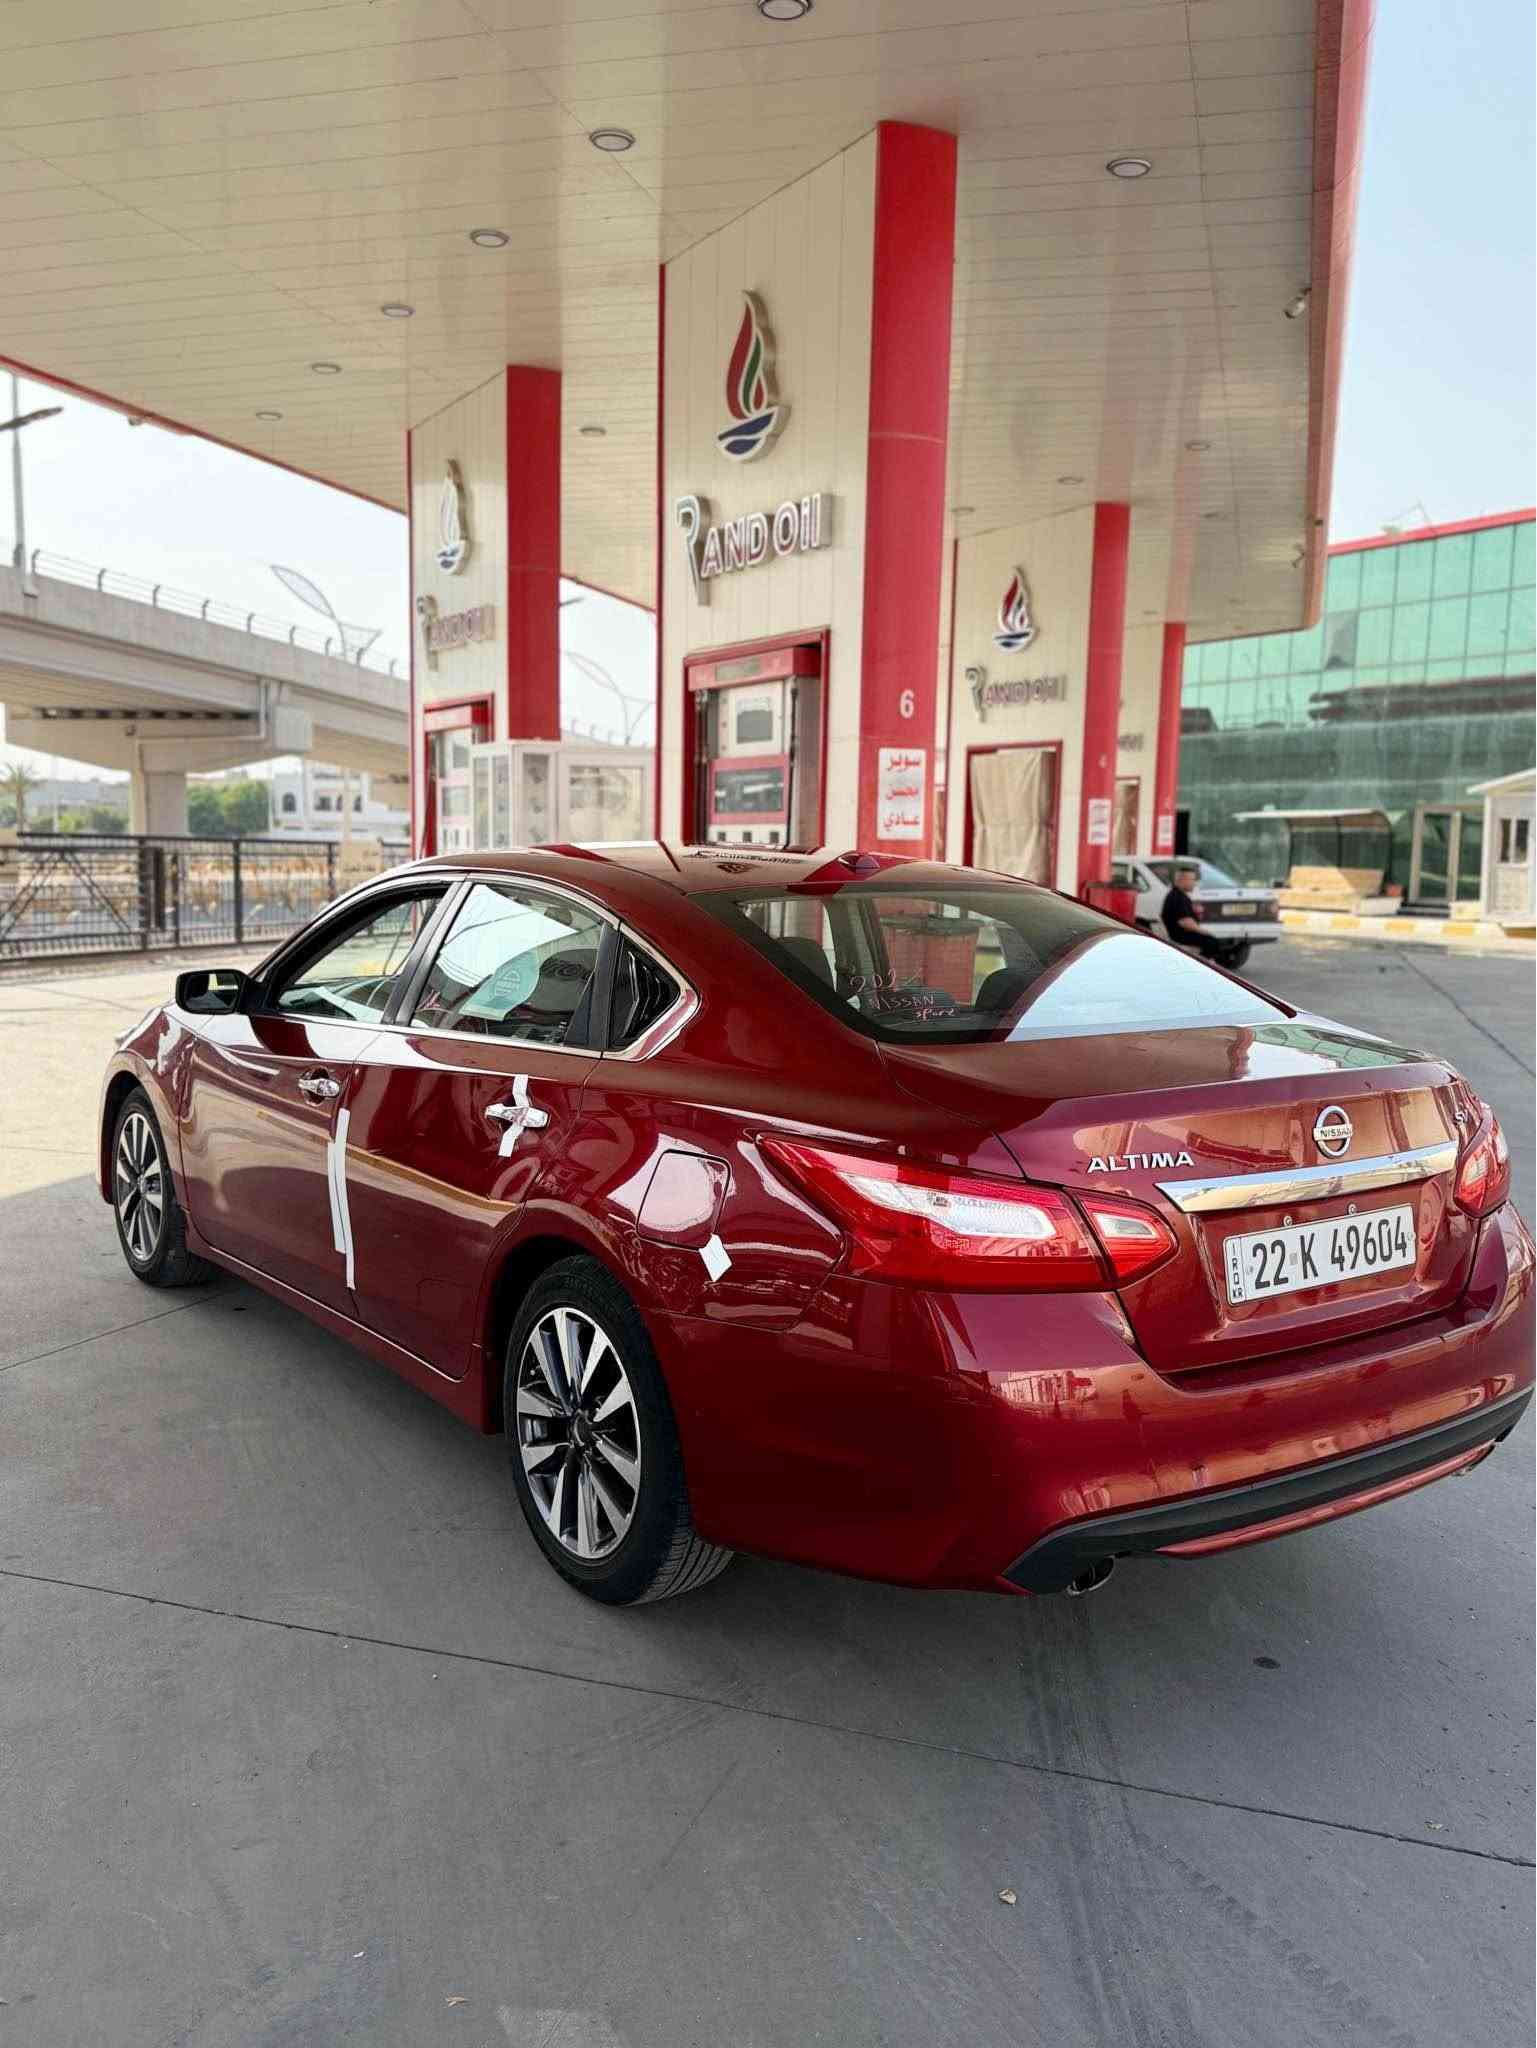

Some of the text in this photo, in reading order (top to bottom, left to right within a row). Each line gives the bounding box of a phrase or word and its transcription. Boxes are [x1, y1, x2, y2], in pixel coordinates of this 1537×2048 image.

[900, 689, 914, 719] 6
[1319, 1127, 1351, 1138] NISSAN
[1086, 1151, 1195, 1174] ALTIMA
[1252, 1215, 1407, 1290] 22 K 49604
